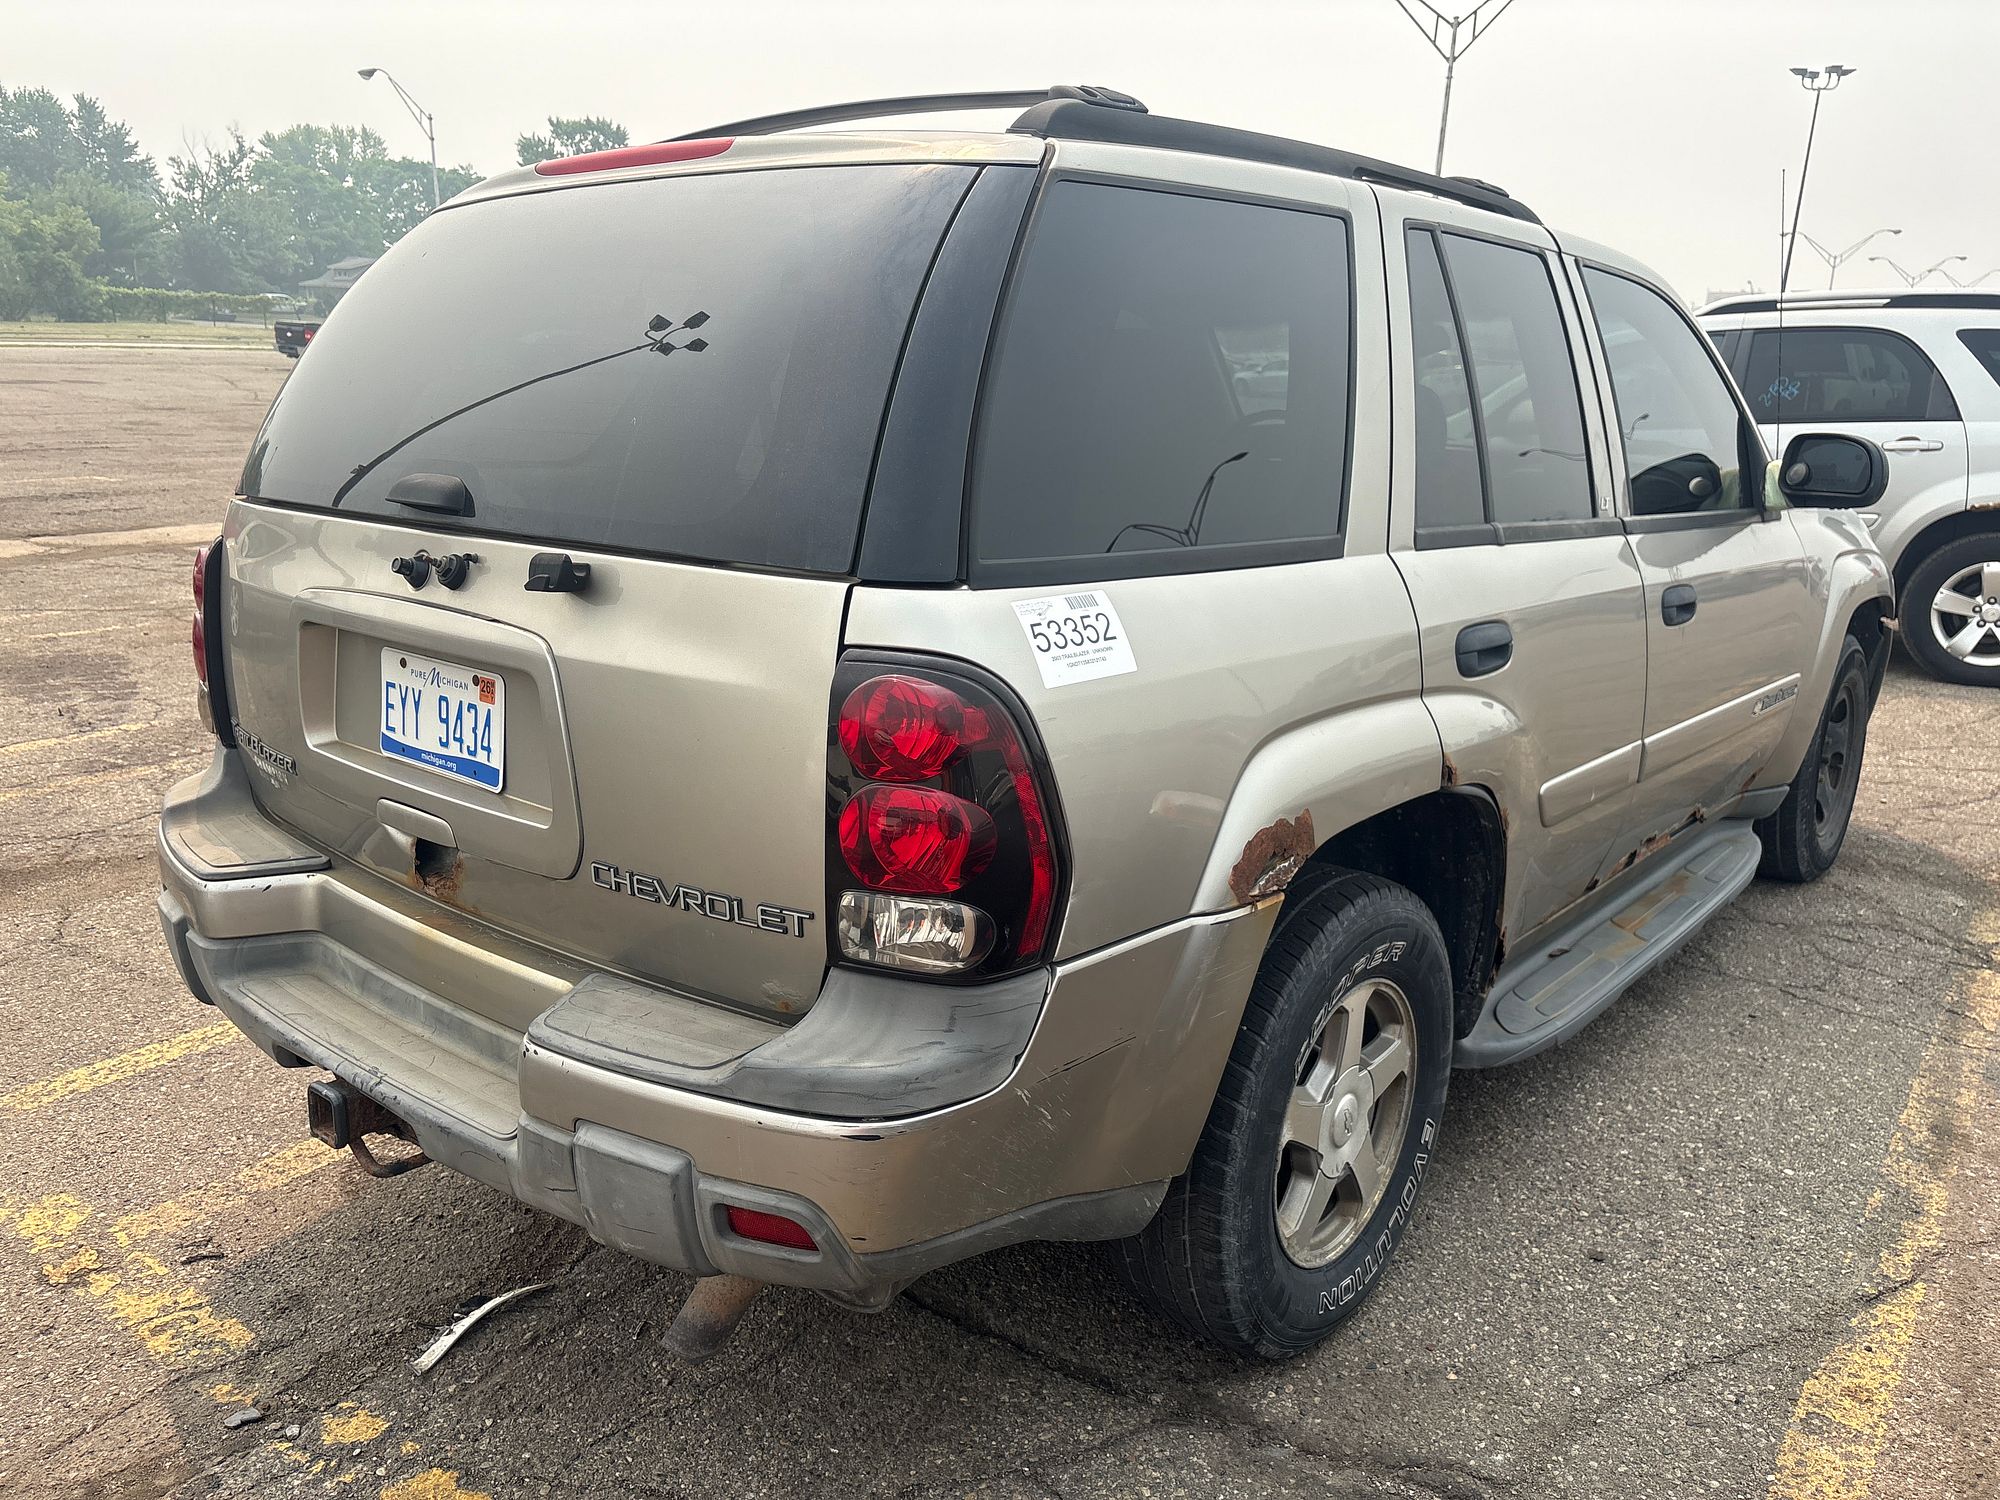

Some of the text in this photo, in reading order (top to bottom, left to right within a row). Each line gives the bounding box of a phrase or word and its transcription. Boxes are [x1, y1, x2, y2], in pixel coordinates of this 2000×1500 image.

[1029, 612, 1117, 653] 53352
[410, 667, 469, 691] PURE MICHIGAN
[480, 679, 491, 694] 26
[385, 680, 493, 763] EYY 9434
[420, 752, 457, 772] michigan.org
[590, 859, 814, 938] CHEVROLET
[1318, 1117, 1436, 1315] EVOLUTION
